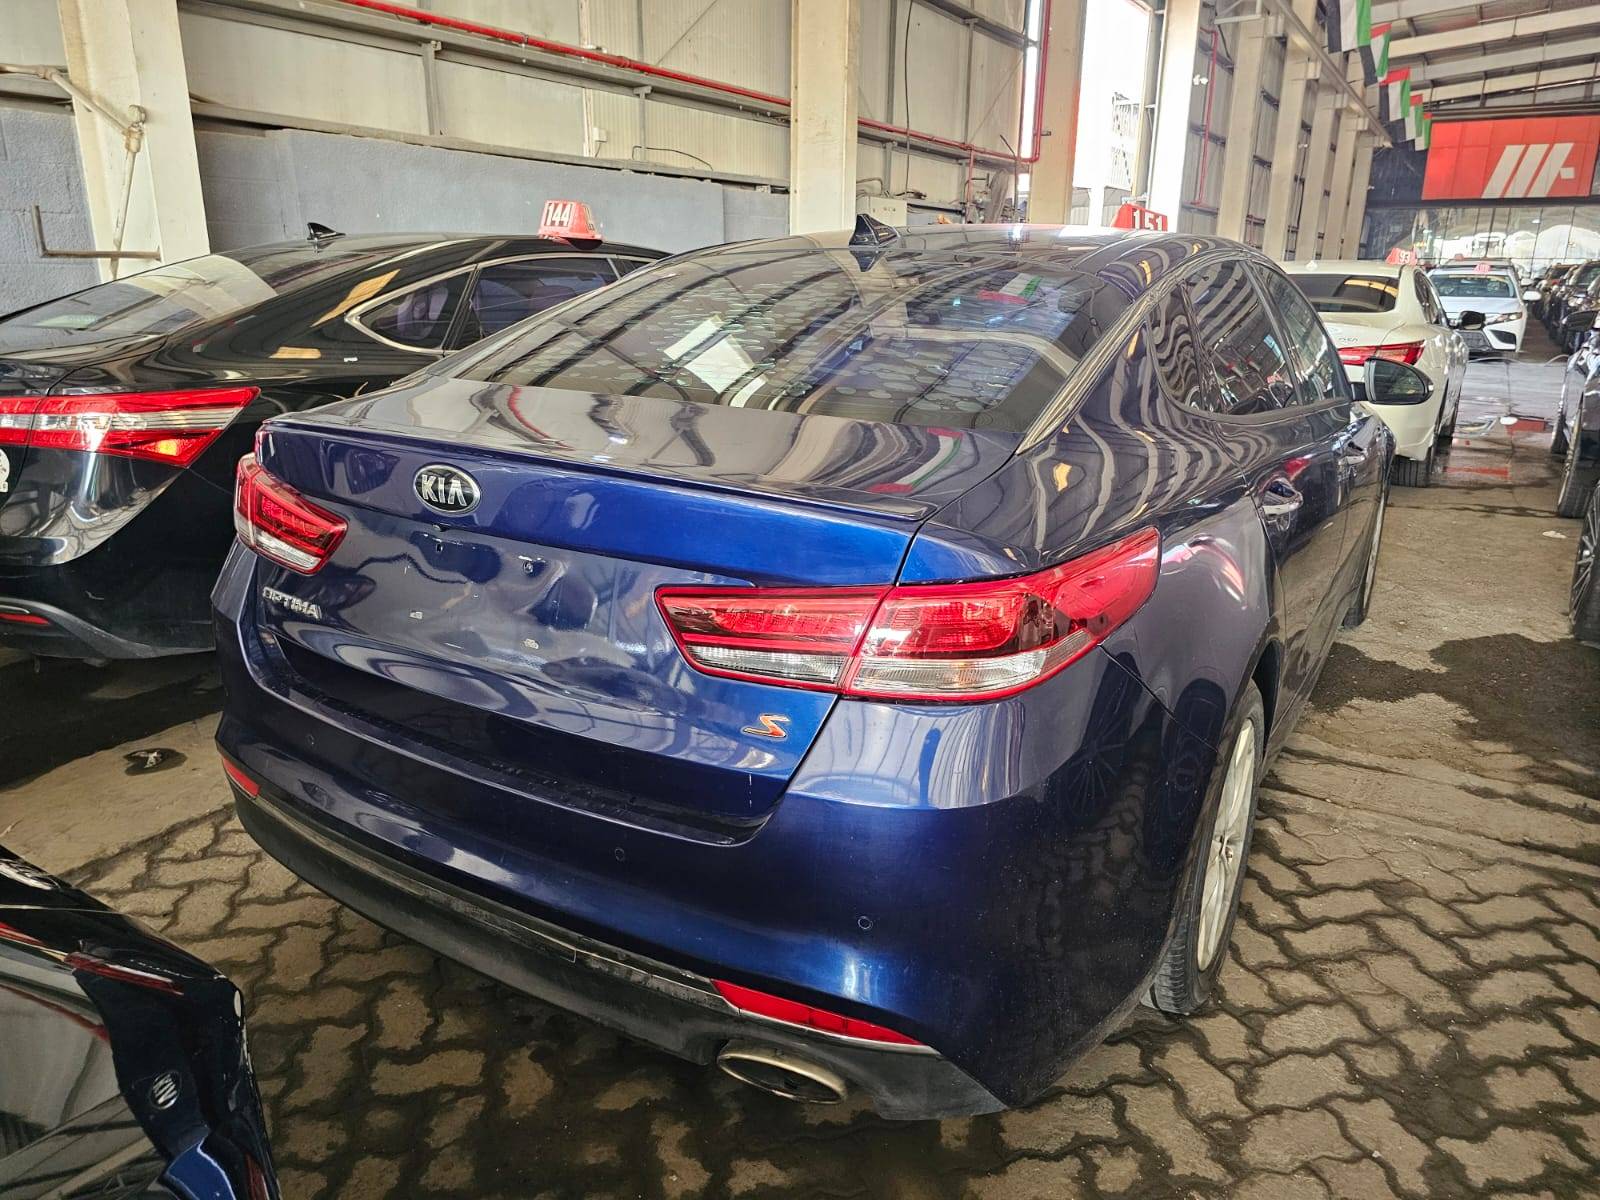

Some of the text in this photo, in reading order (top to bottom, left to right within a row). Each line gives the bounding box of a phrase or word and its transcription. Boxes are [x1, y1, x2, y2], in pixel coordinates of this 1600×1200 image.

[545, 201, 571, 227] 144
[1133, 209, 1163, 231] 151
[1399, 250, 1411, 264] 93
[421, 474, 468, 507] KIA
[262, 586, 322, 620] OPTIMA
[741, 713, 790, 741] S
